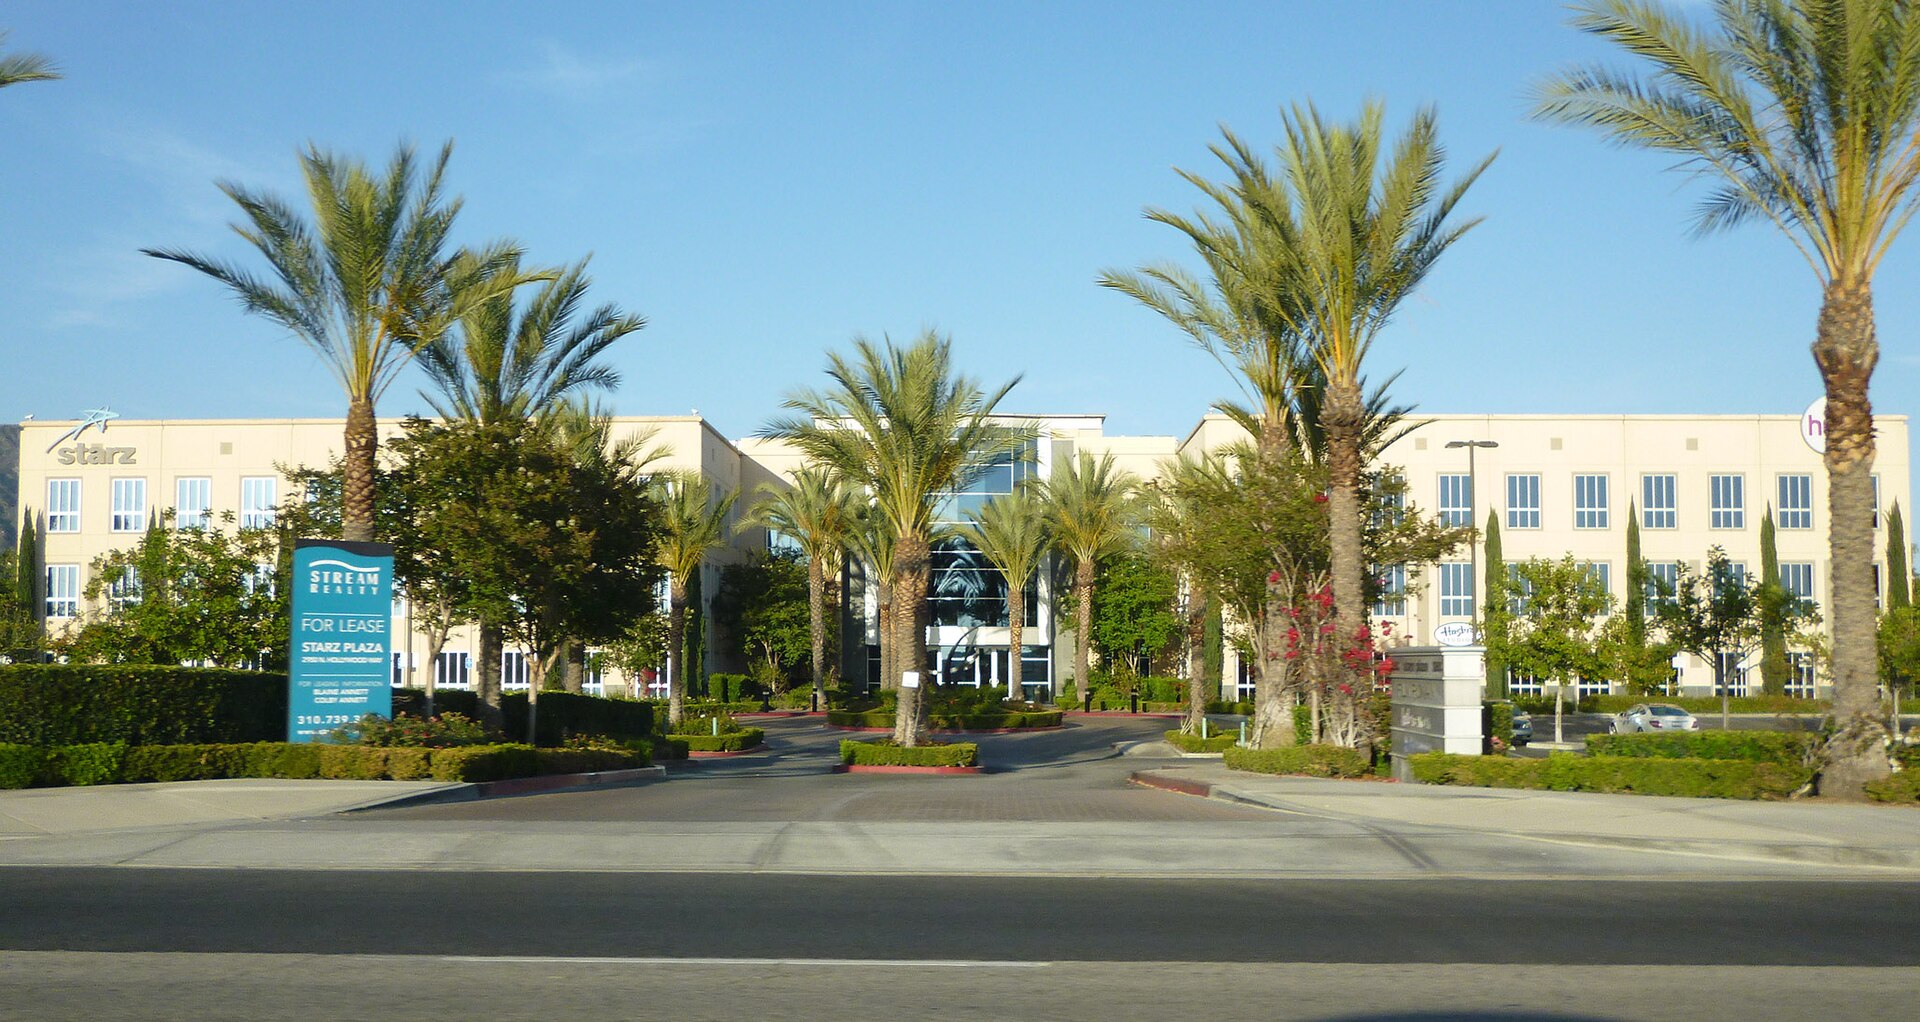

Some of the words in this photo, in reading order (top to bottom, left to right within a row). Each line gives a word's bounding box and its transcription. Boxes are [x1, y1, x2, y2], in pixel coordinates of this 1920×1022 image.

[57, 443, 137, 465] starz
[310, 570, 379, 585] STREAM
[310, 583, 379, 595] REALTY
[301, 618, 334, 632] FOR
[339, 619, 385, 633] LEASE
[301, 641, 341, 653] STARZ
[343, 642, 384, 653] PLAZA
[297, 715, 362, 725] 310.739.3
